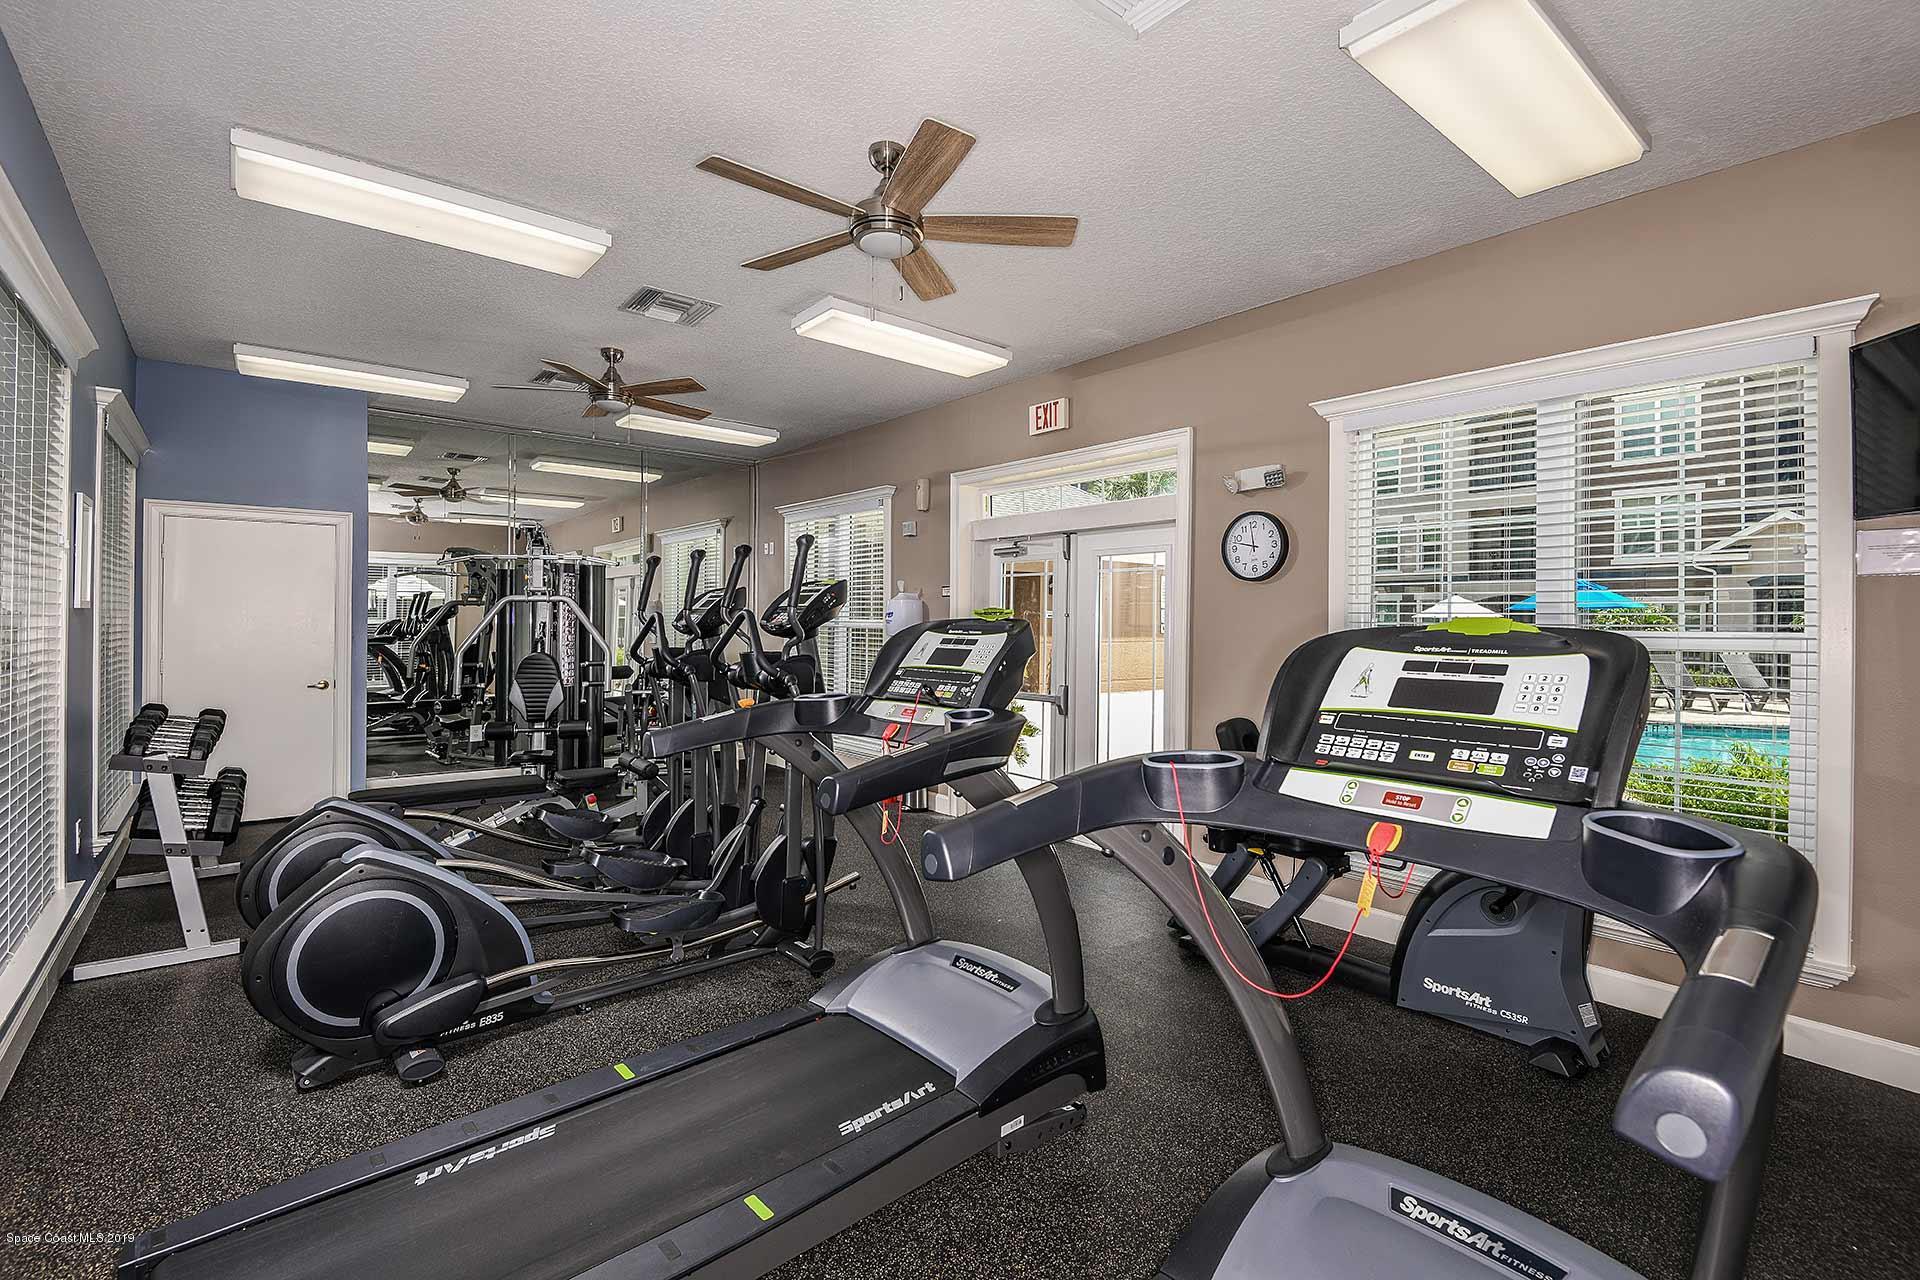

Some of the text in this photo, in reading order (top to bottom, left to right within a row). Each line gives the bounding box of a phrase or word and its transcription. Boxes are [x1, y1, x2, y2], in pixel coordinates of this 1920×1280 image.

[1035, 401, 1059, 430] EXIT
[1232, 545, 1237, 553] 9
[1413, 645, 1509, 655] SportsArt TREADMILL
[1394, 794, 1411, 802] STOP
[956, 957, 999, 983] SportsArt
[1423, 977, 1492, 1008] SportsArt
[479, 1011, 504, 1028] E835
[1465, 1001, 1498, 1015] FITNESS
[838, 1081, 936, 1136] SportsArt
[414, 1124, 557, 1186] SportsArt
[1400, 1195, 1554, 1280] SportsArt FITNESS
